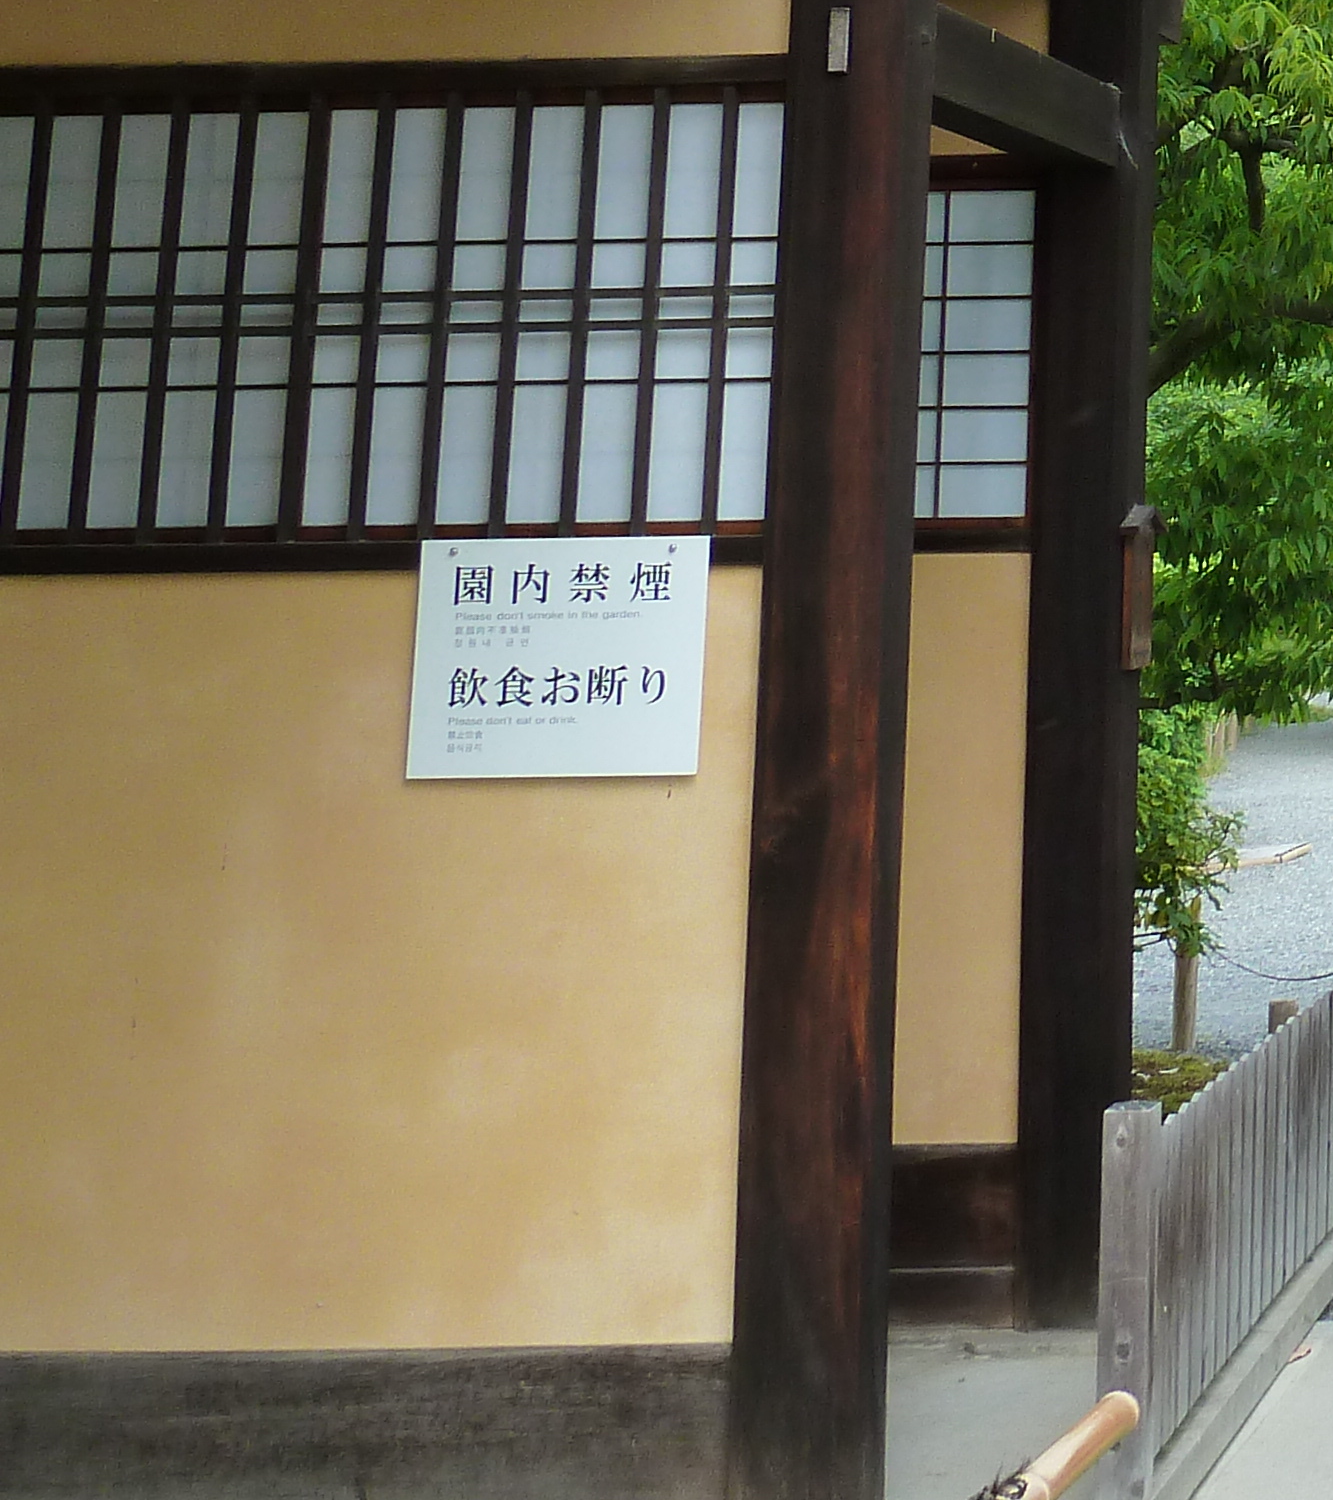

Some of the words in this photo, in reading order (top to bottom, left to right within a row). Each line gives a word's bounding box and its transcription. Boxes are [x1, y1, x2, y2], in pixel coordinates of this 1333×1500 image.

[453, 561, 672, 605] 園内禁煙
[455, 611, 492, 621] Please
[568, 610, 578, 619] in
[581, 610, 598, 620] the
[447, 665, 667, 708] 飲食お断り
[447, 716, 483, 726] Please
